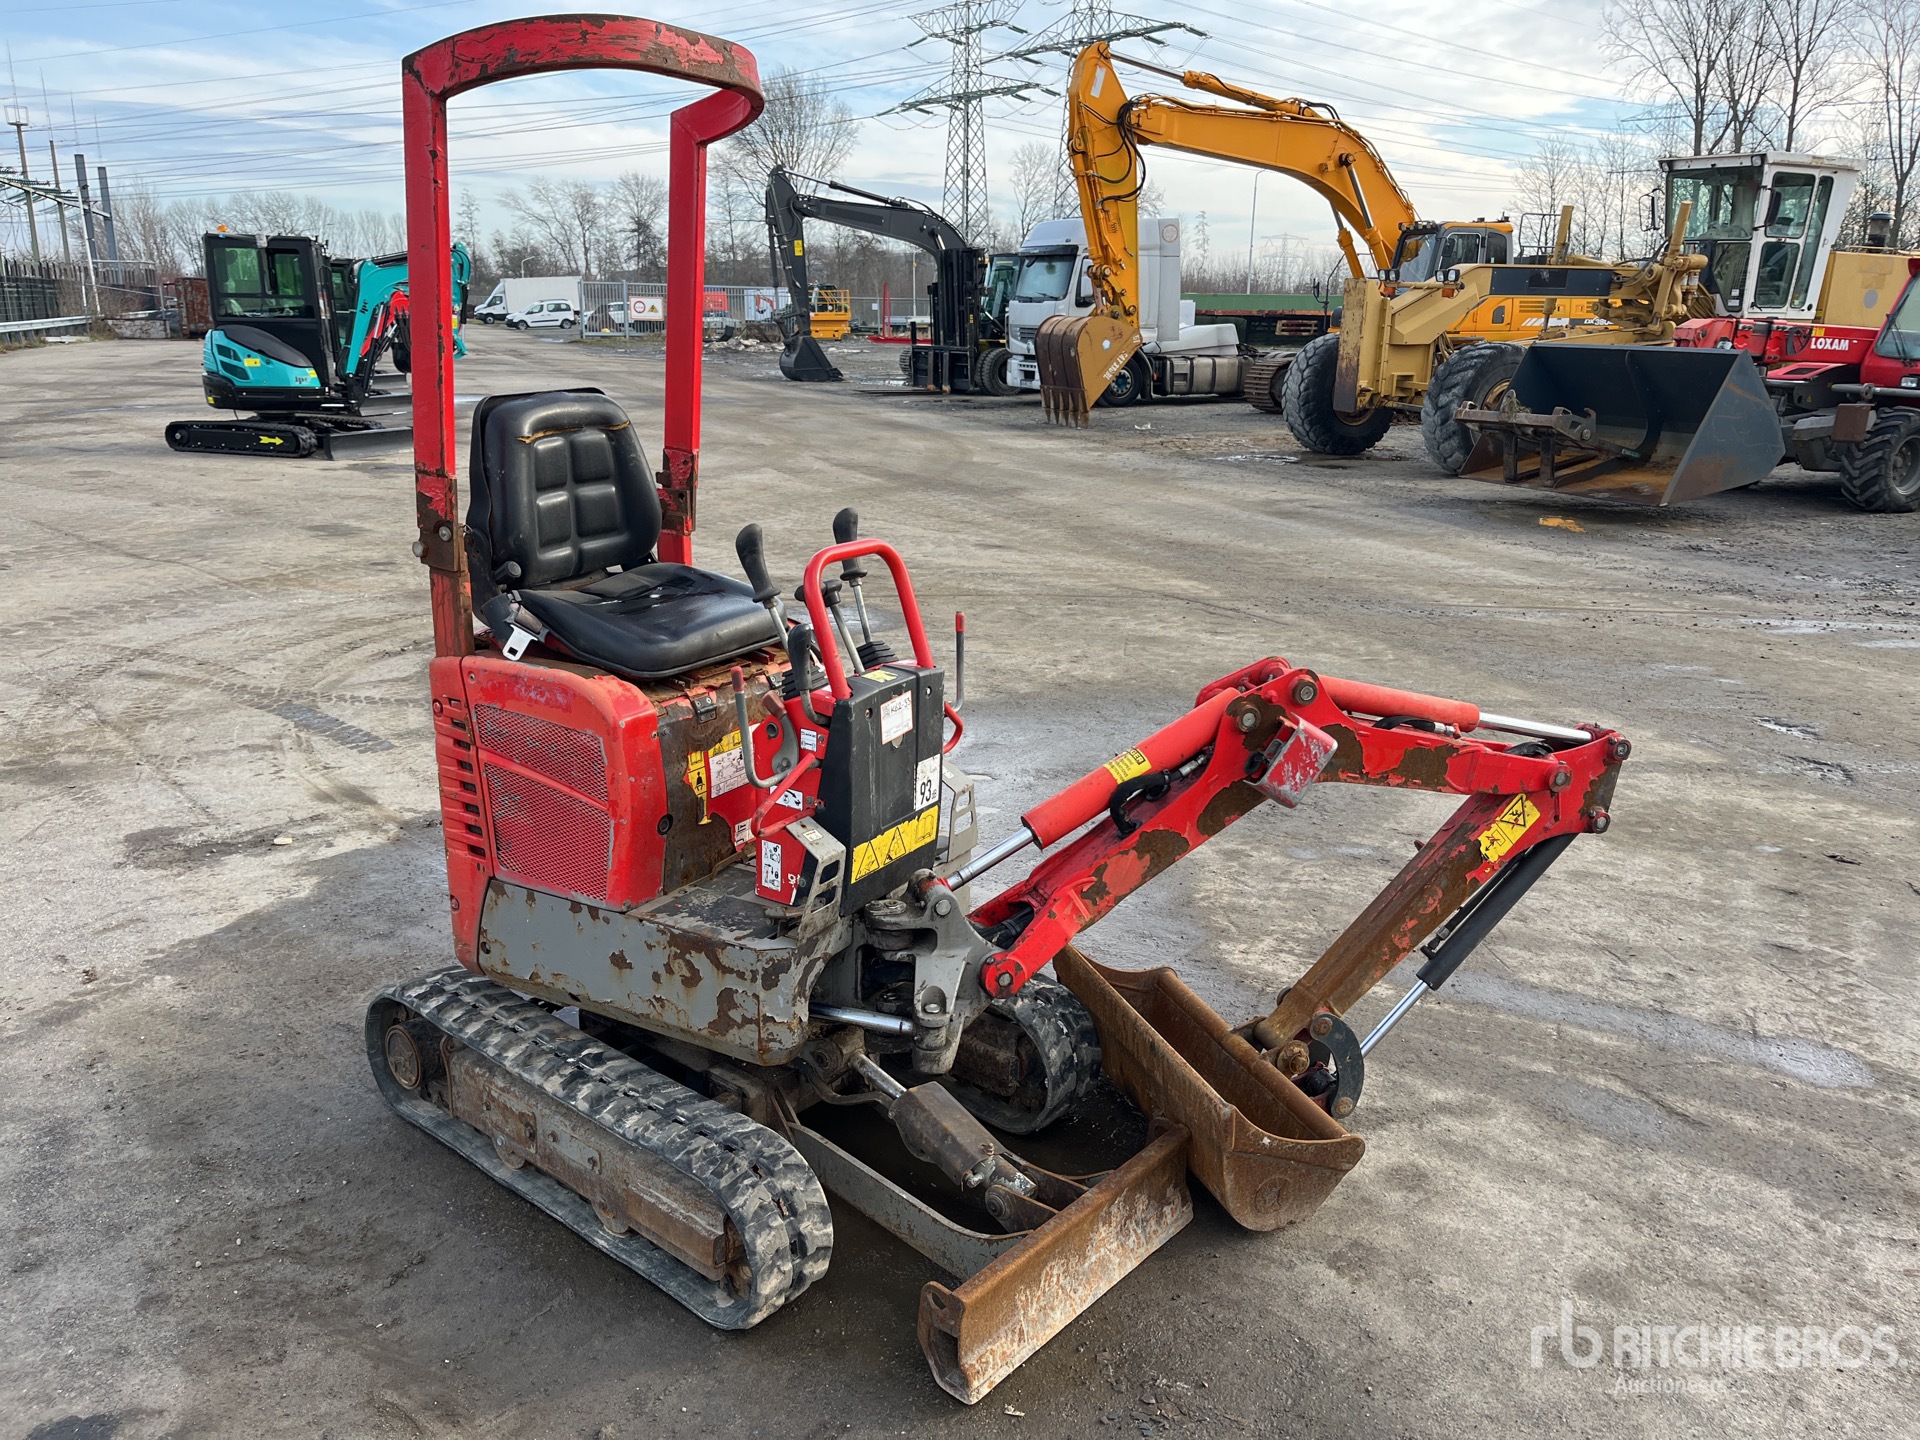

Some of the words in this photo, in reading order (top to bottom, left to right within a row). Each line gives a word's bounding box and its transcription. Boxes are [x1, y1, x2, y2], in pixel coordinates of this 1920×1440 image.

[1810, 337, 1849, 351] LOXAM
[1116, 350, 1129, 365] CAT
[920, 779, 932, 804] 93
